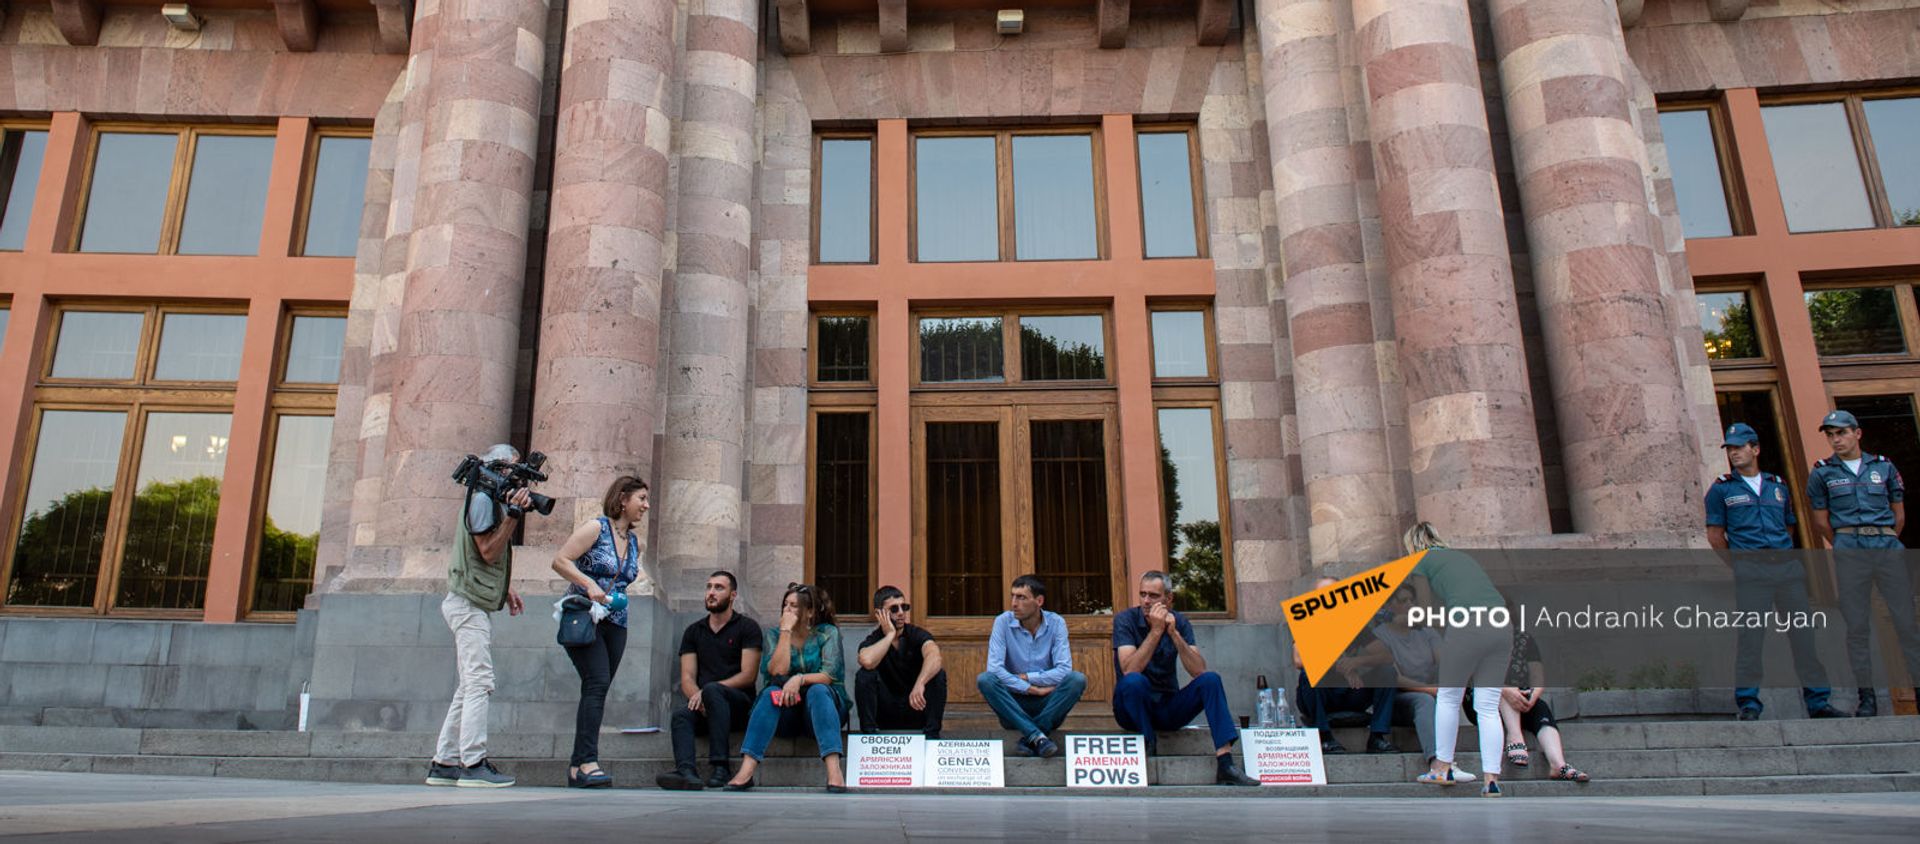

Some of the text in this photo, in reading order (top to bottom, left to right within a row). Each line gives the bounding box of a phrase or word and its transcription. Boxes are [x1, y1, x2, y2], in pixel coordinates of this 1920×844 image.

[861, 736, 912, 745] СВОБОДУ
[872, 746, 901, 754] ВСЕМ
[1073, 737, 1138, 754] FREE
[938, 757, 990, 766] GENEVA
[1075, 757, 1139, 766] ARMENIAN
[1075, 768, 1140, 785] POWs
